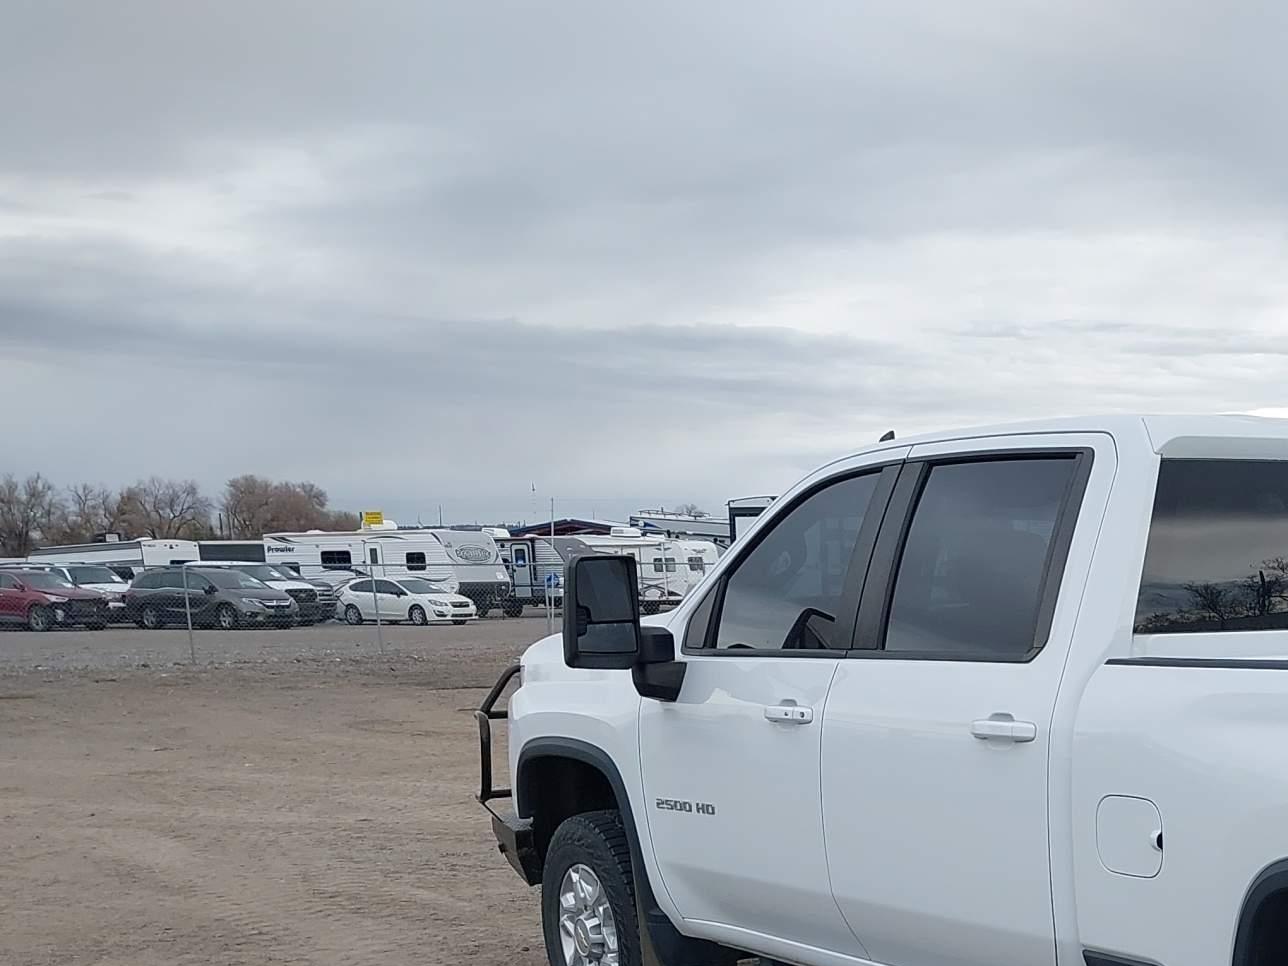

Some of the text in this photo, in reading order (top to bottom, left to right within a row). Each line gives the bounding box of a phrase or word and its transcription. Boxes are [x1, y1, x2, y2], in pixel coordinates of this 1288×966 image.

[267, 545, 295, 554] Prowler
[656, 798, 716, 815] 2500 HD
